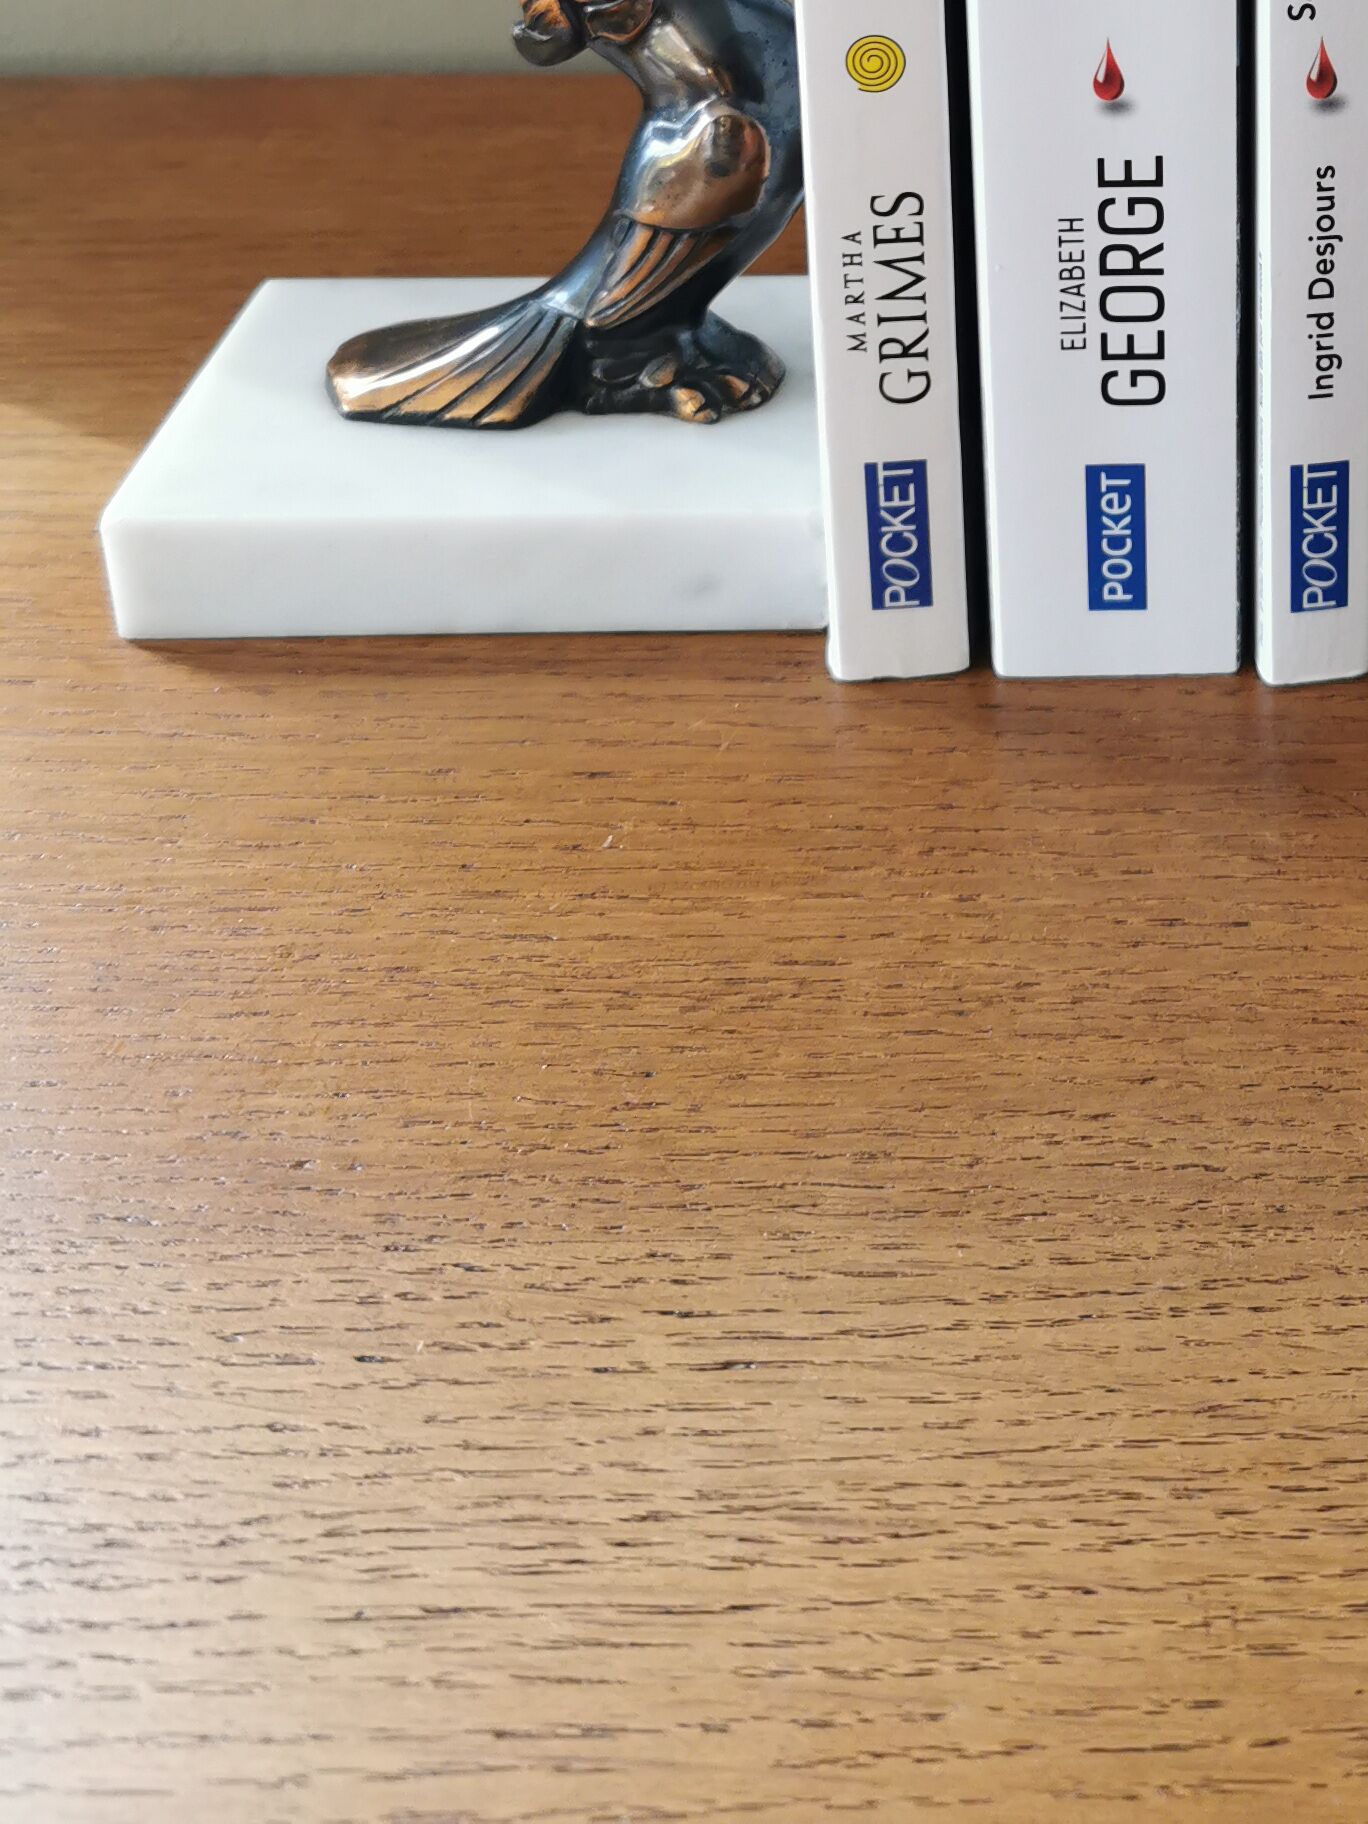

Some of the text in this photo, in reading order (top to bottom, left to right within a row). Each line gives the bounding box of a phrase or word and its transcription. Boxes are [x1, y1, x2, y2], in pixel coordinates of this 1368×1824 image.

[841, 231, 868, 353] MARTHA
[870, 192, 932, 405] GRIMES
[1058, 218, 1087, 352] ELIZABETH
[1097, 154, 1166, 407] GEORGE
[1306, 166, 1344, 400] Ingrid Desjours
[876, 461, 920, 608] POCKET
[1301, 464, 1338, 609] POCKET
